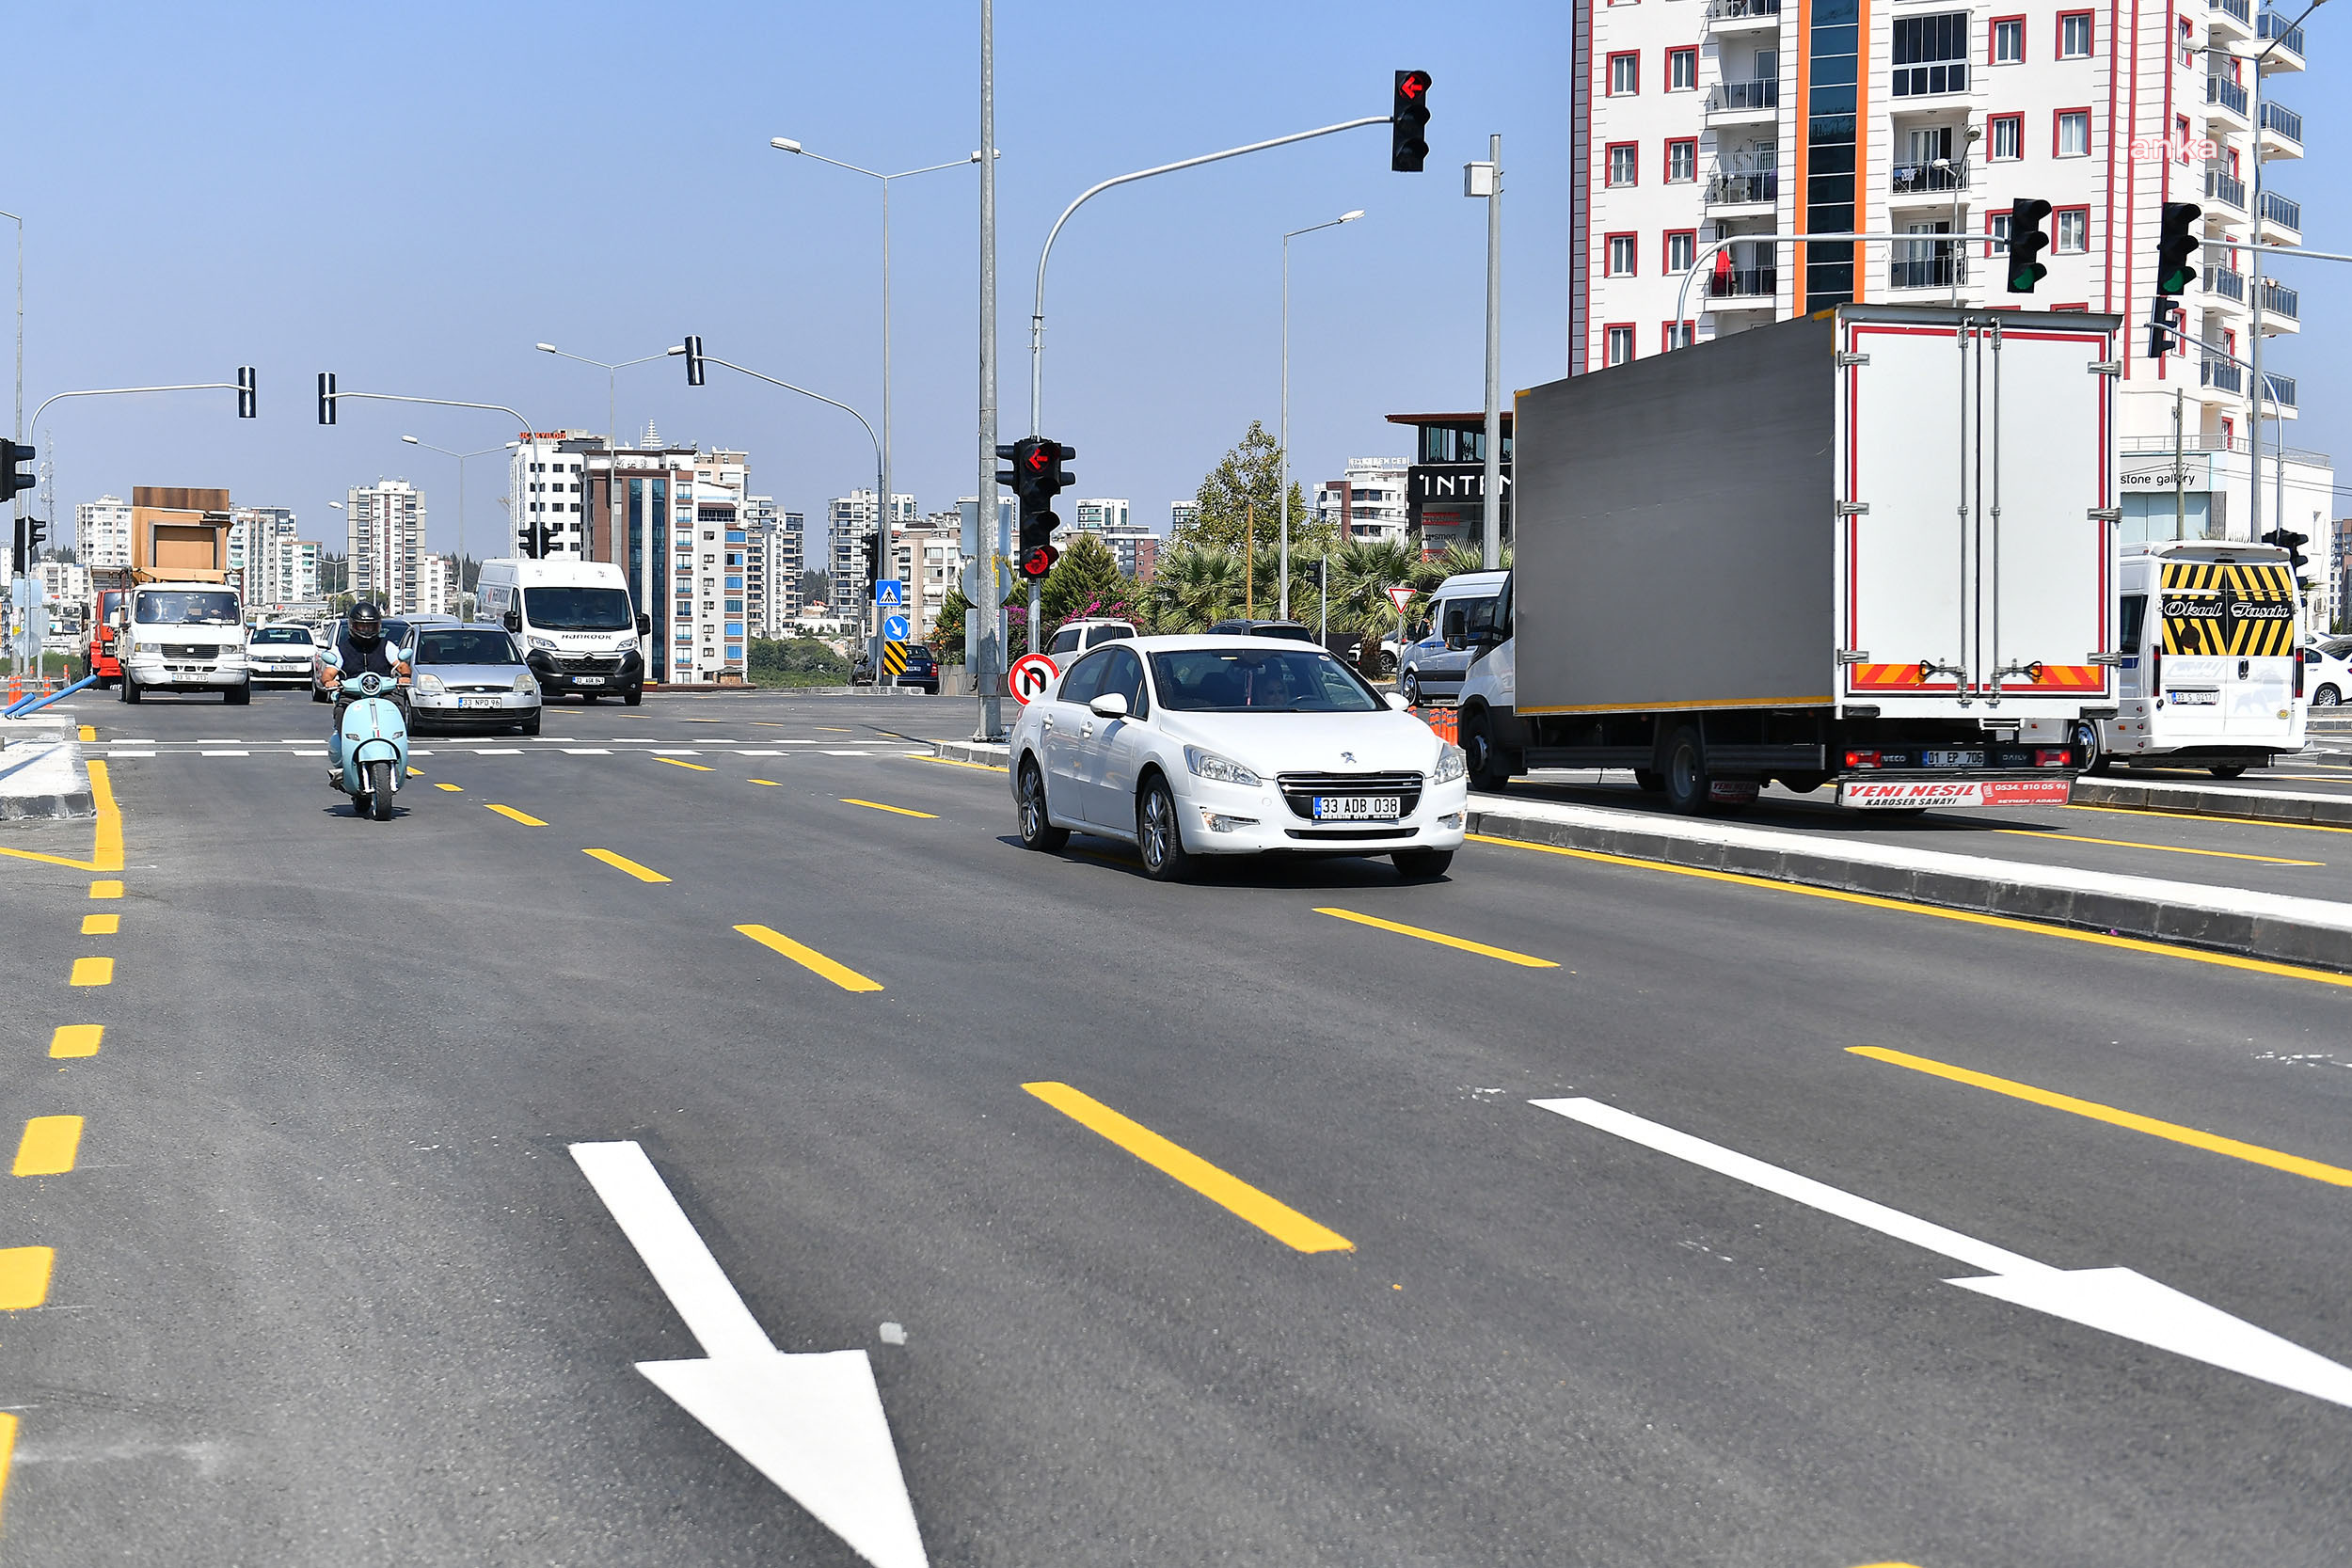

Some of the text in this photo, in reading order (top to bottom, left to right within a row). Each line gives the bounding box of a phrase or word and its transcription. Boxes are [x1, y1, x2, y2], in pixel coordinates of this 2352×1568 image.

[519, 432, 566, 440] UÇKYILDIZ
[1929, 752, 1939, 764] 01
[1947, 752, 1959, 764] EP
[1323, 799, 1398, 814] 33 ADB 038
